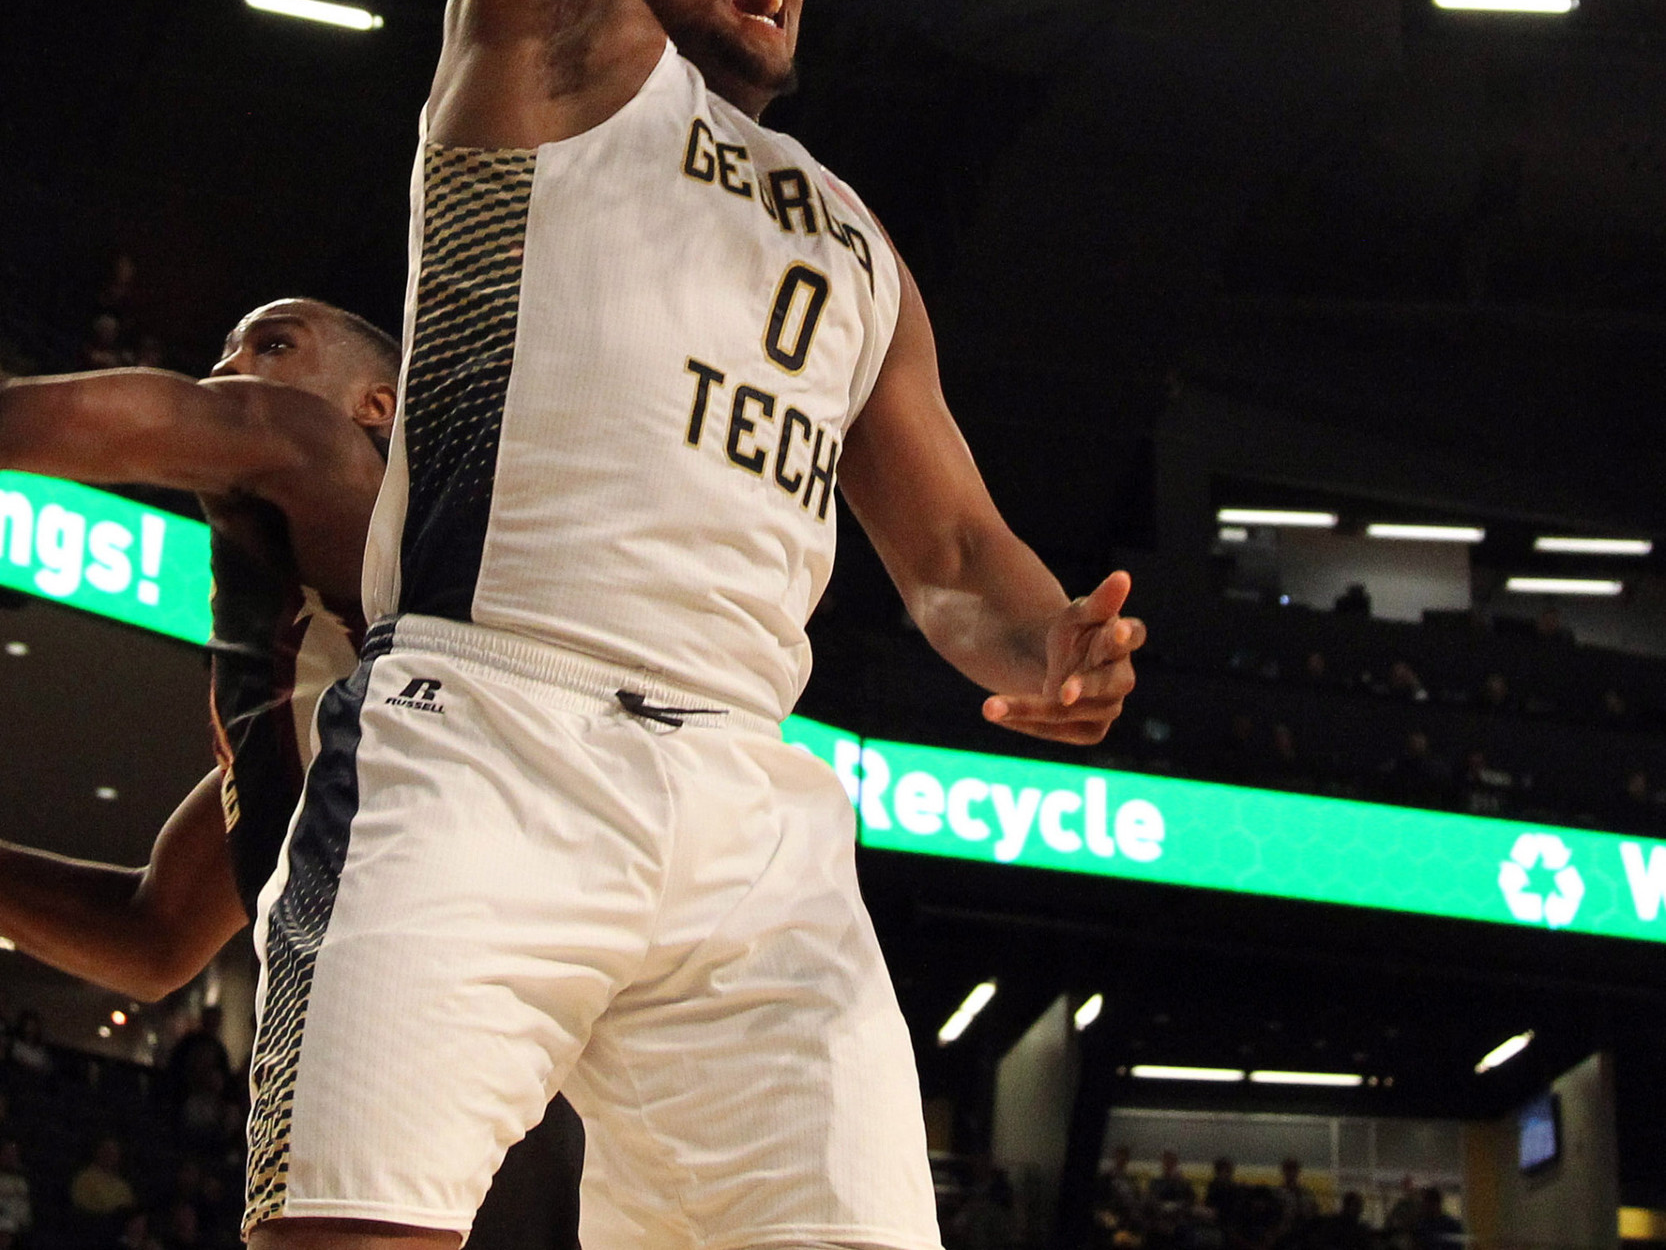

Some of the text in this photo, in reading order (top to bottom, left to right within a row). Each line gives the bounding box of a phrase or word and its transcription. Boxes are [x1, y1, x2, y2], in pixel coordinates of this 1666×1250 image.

[762, 260, 831, 377] 0
[683, 355, 839, 524] TECH
[0, 489, 166, 607] ngs!
[384, 696, 446, 715] RUSSELL
[833, 738, 1166, 863] Recycle
